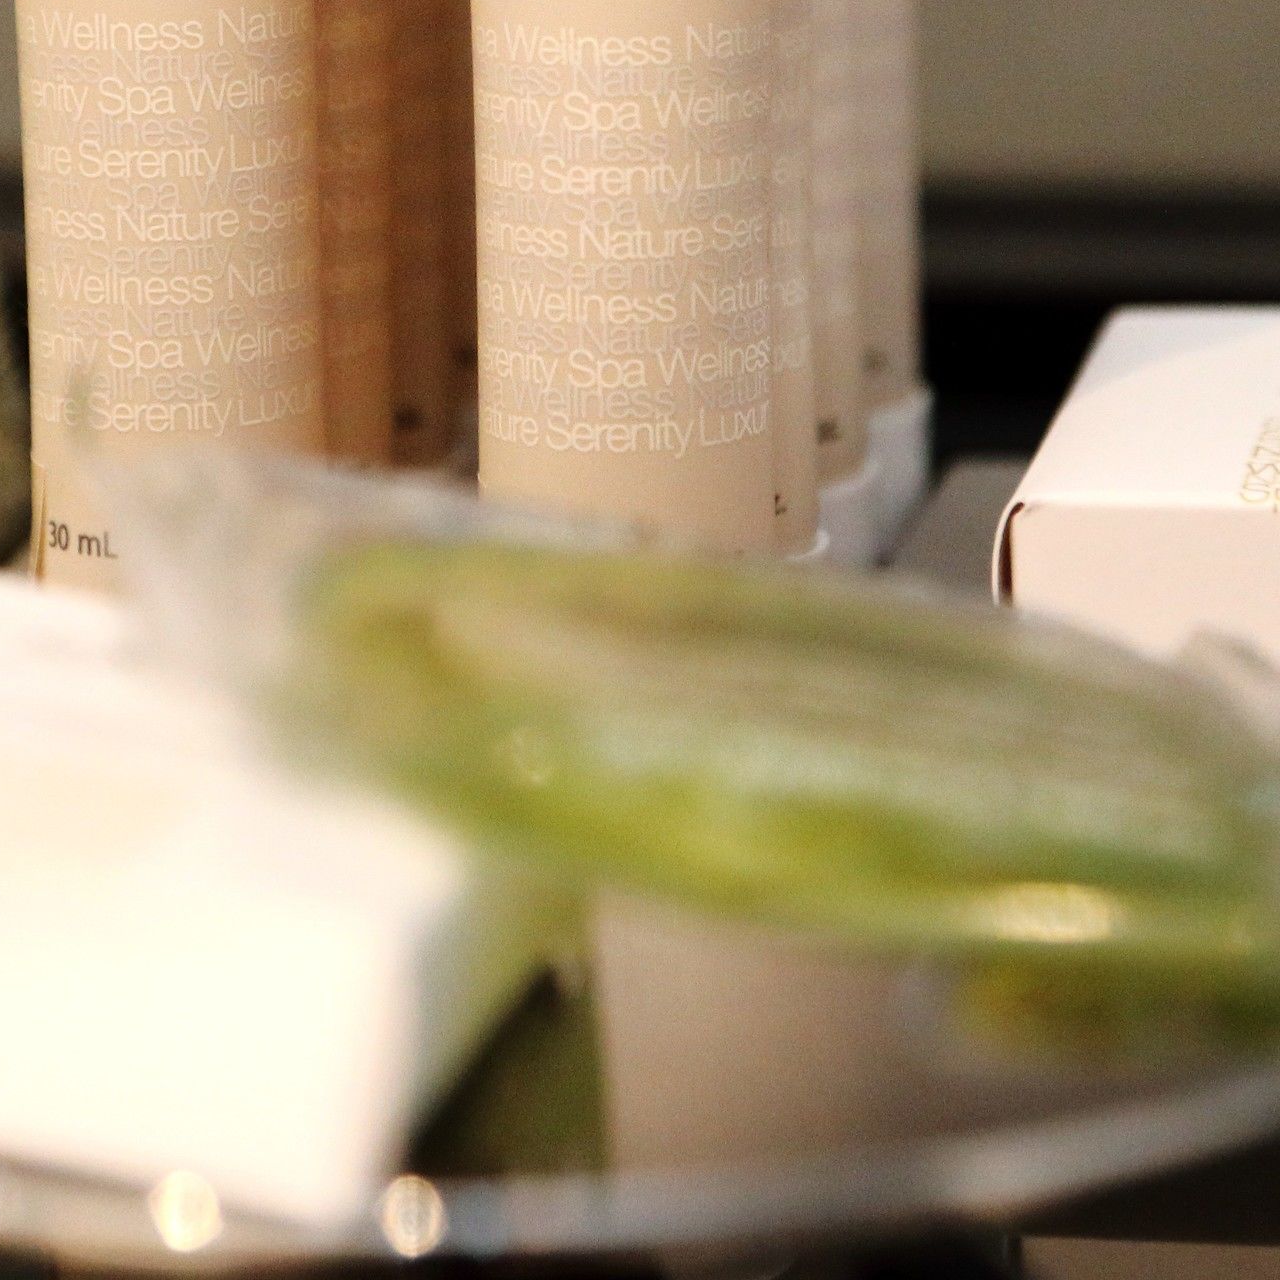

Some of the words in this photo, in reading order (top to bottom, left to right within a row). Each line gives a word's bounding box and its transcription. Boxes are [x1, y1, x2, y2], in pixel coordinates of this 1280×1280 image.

[39, 8, 205, 51] Wellness
[503, 21, 672, 66] Wellness
[98, 76, 176, 124] Spa
[562, 90, 642, 138] Spa
[77, 139, 226, 187] Serenity
[539, 154, 691, 206] Serenity
[117, 203, 240, 243] Nature
[578, 219, 705, 262] Nature
[49, 260, 215, 307] Wellness
[510, 276, 678, 325] Wellness
[107, 328, 182, 376] Spa
[567, 346, 646, 397] Spa
[87, 389, 233, 438] Serenity
[545, 410, 696, 461] Serenity
[47, 521, 70, 551] 30
